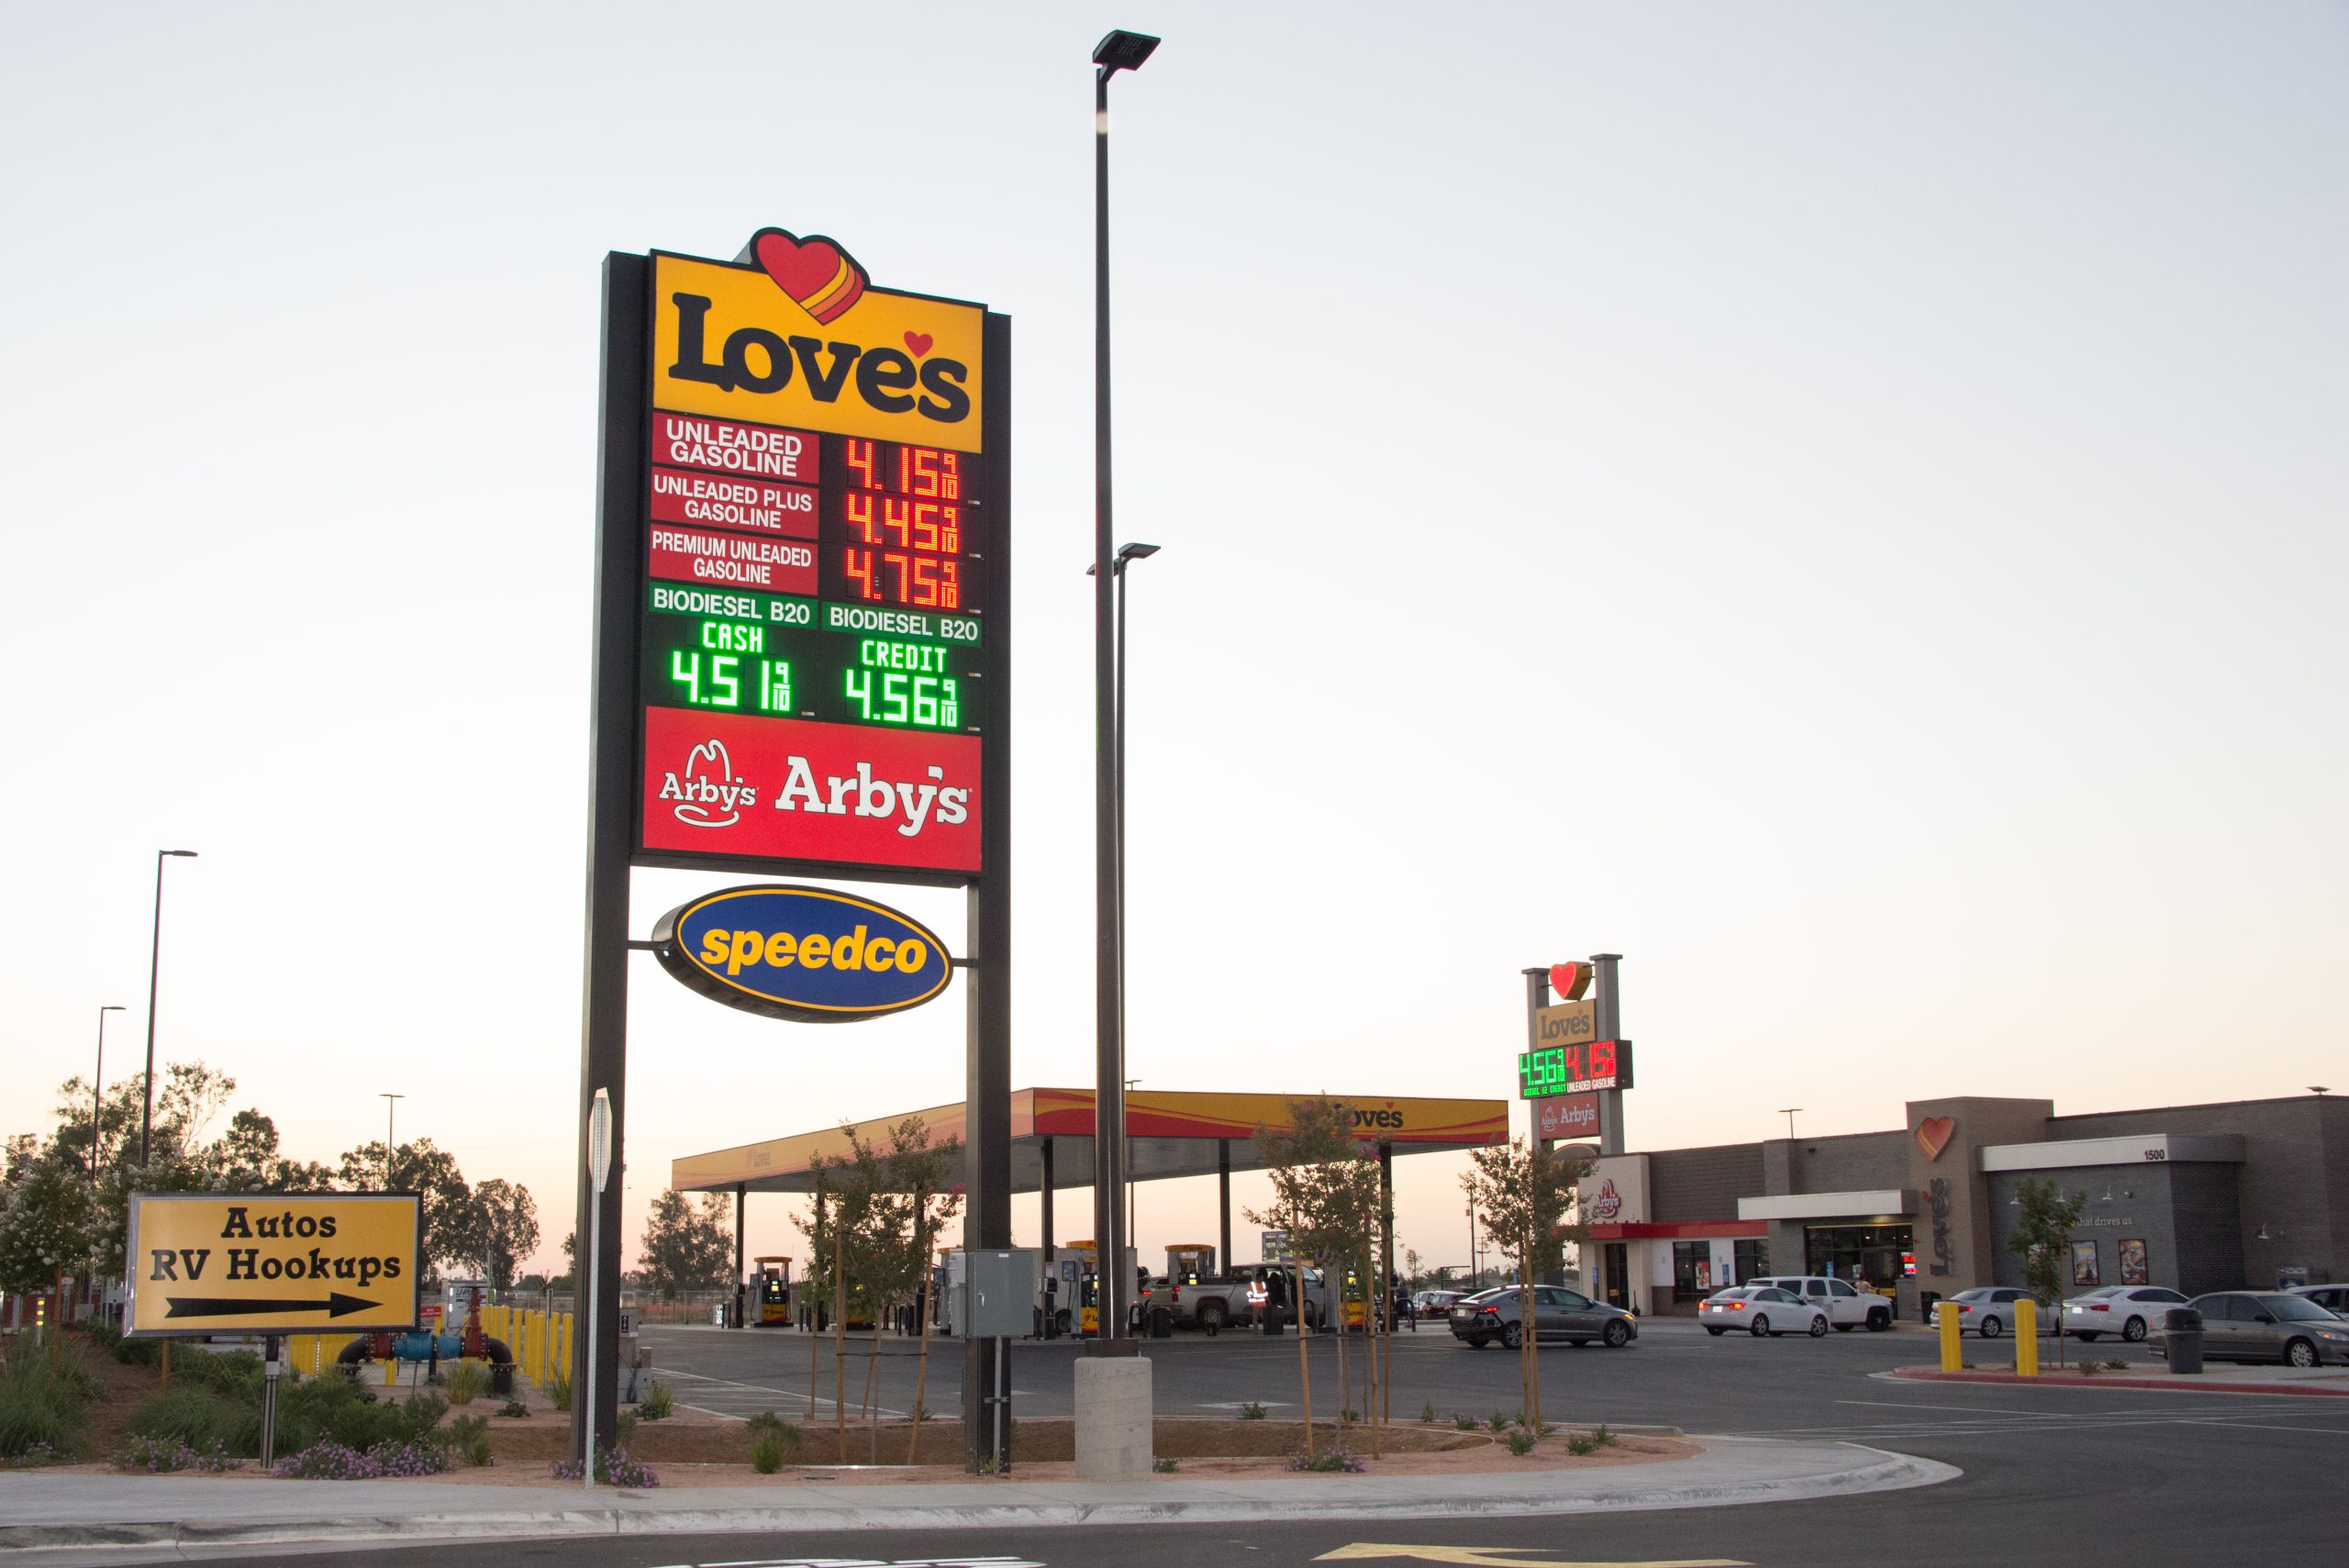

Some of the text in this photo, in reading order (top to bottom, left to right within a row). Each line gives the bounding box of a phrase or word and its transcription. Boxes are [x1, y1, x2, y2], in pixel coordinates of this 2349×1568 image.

[666, 418, 802, 457] UNLEADED
[670, 440, 797, 477] GASOLINE
[653, 474, 813, 513] UNLEADED PLUS
[685, 499, 782, 529] GASOLINE
[652, 530, 812, 567] PREMIUM UNLEADED
[693, 557, 771, 584] GASOLINE
[653, 587, 810, 625] BIODIESEL B20
[830, 606, 978, 641] BIODIESEL B20
[703, 621, 763, 653] CASH
[862, 639, 947, 673] CREDIT
[659, 772, 756, 811] Arby's
[774, 755, 969, 837] Arby's
[700, 925, 927, 976] speedco
[1566, 1076, 1616, 1093] UNLEADED GASOLINE
[1560, 1103, 1595, 1127] Arby's
[2143, 1149, 2165, 1161] 1500
[221, 1207, 337, 1238] Autos
[2094, 1217, 2121, 1226] drives
[150, 1248, 401, 1287] RV Hookups
